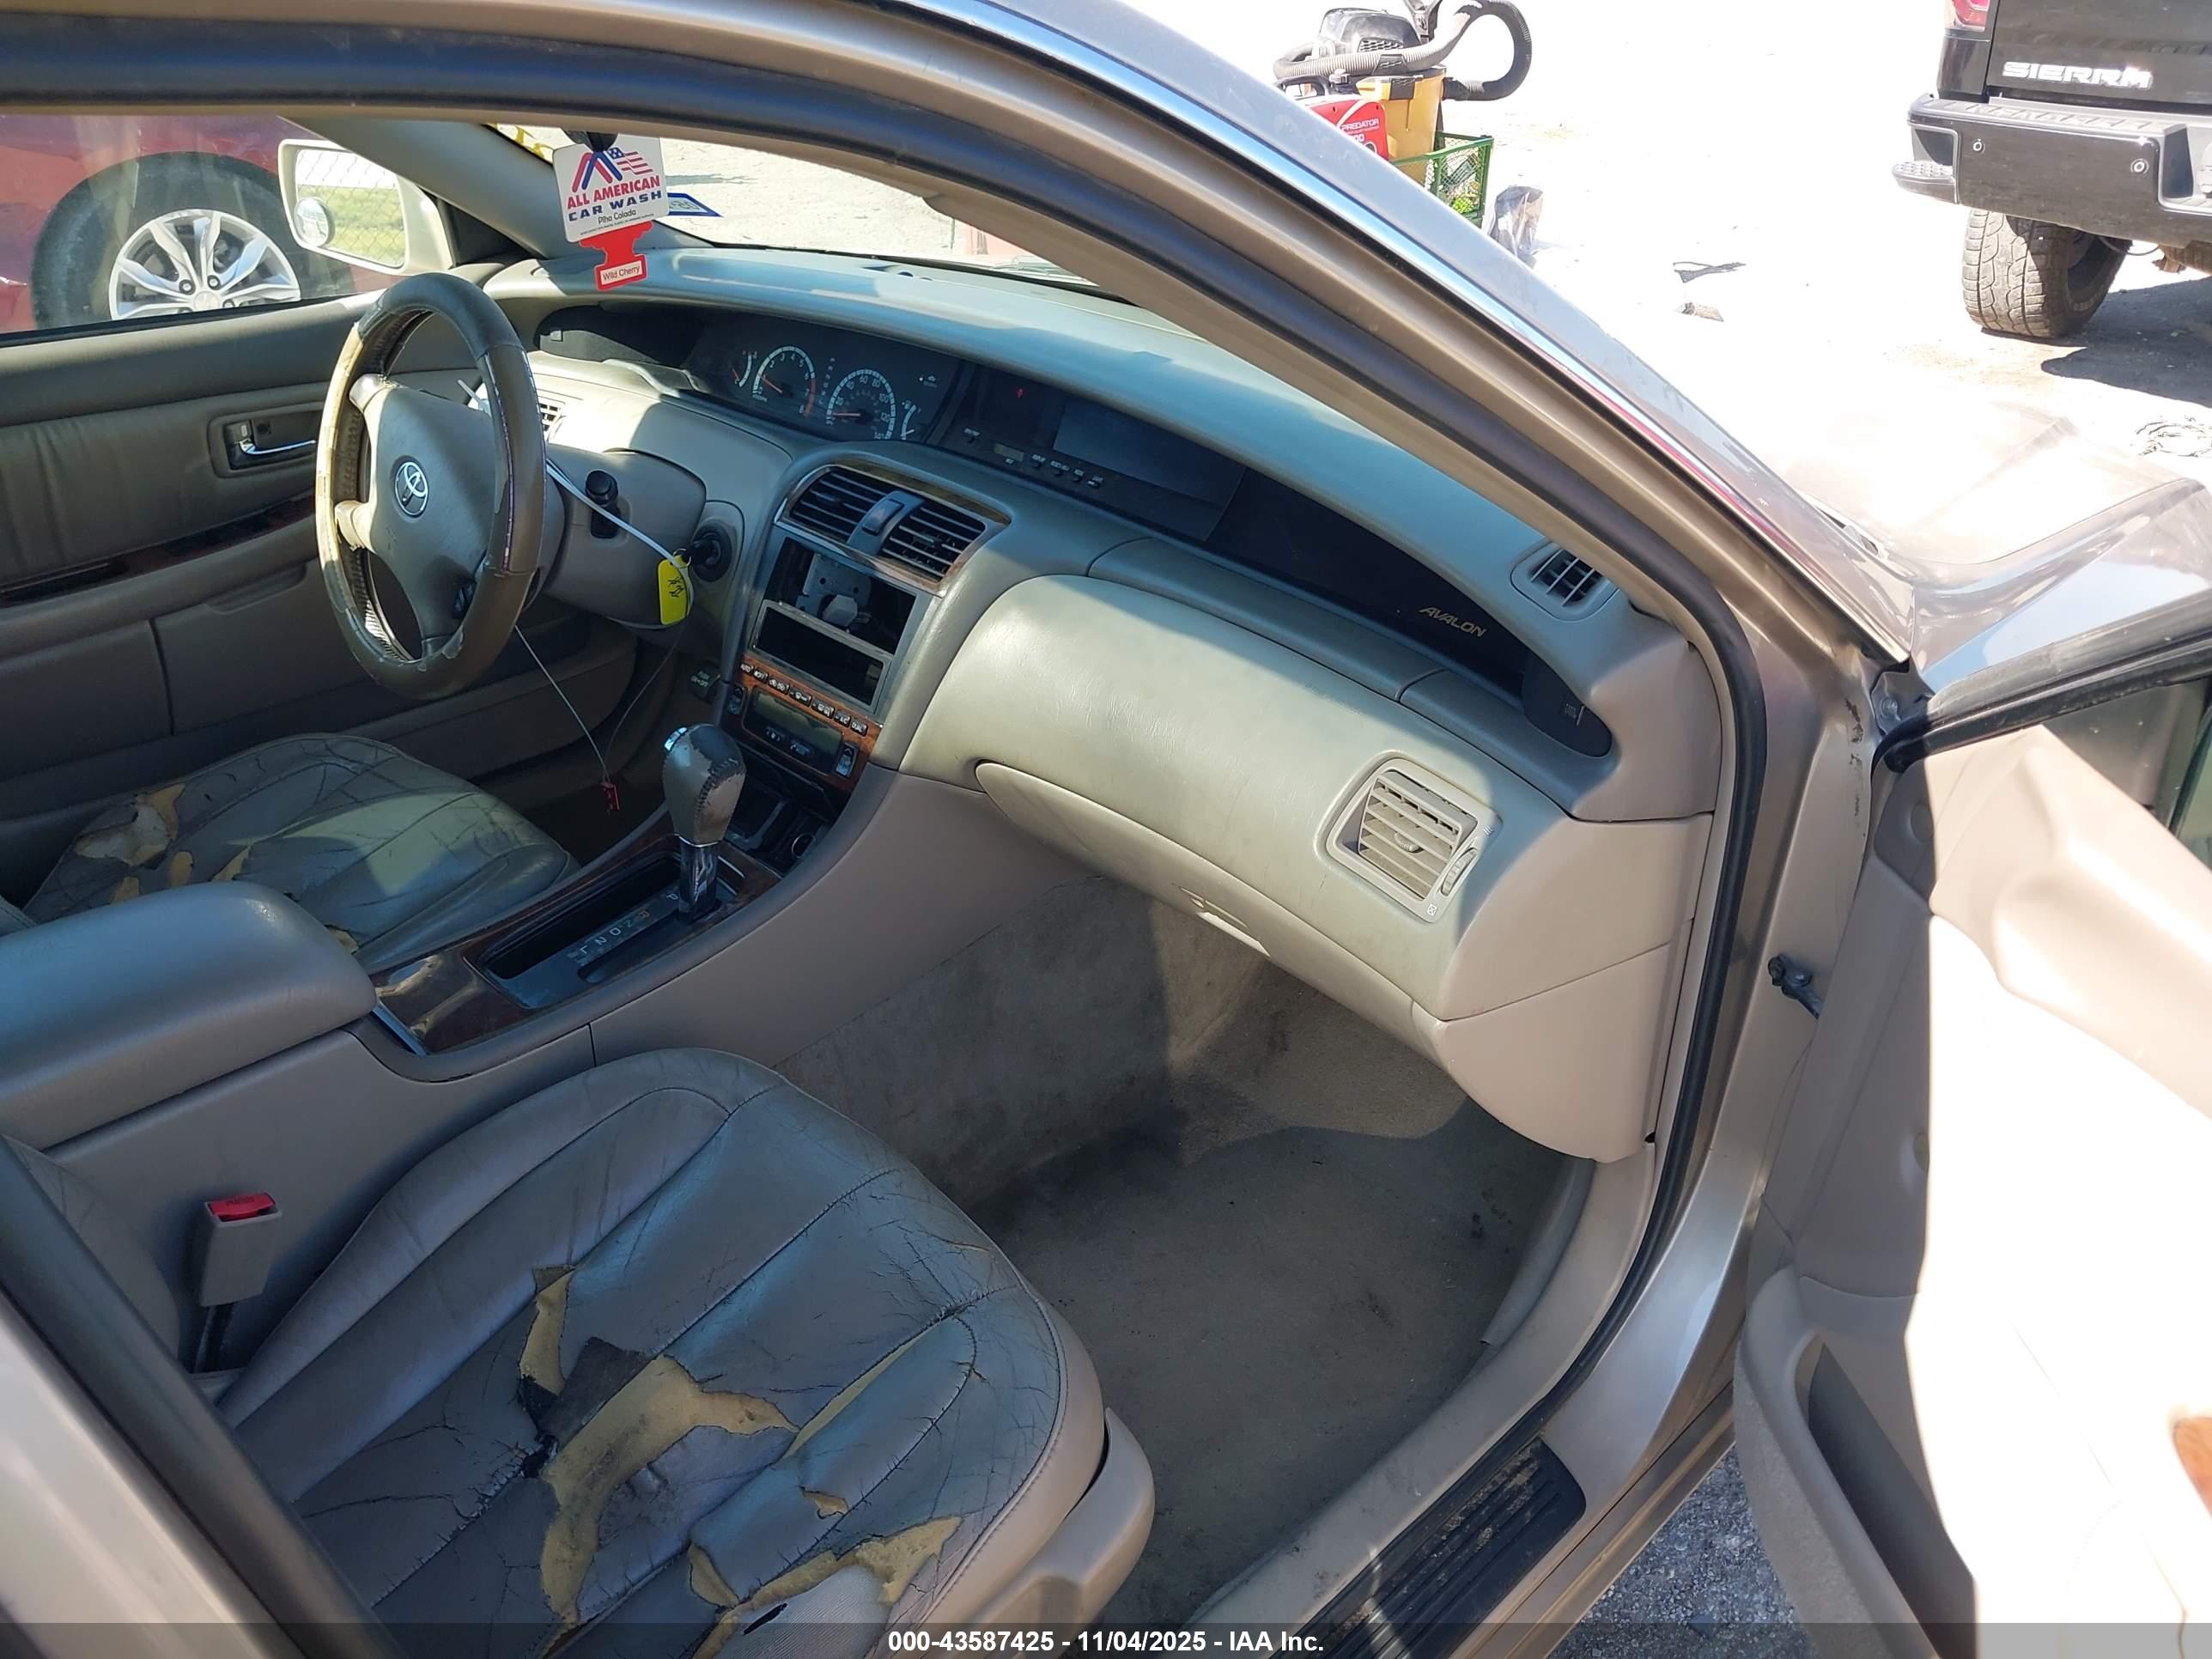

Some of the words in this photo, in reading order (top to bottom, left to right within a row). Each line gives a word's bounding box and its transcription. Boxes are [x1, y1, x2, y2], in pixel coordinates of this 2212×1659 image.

[2002, 61, 2153, 89] SIERRA
[1341, 118, 1379, 131] PREDATOR
[568, 193, 590, 210] ALL
[593, 175, 660, 202] AMERICAN
[568, 205, 603, 222] CAR
[610, 191, 661, 210] WASH
[614, 209, 636, 221] Colada
[602, 270, 617, 281] Wild
[619, 265, 640, 276] Cherry
[1419, 606, 1487, 637] AVALON
[610, 927, 622, 936] D
[580, 945, 588, 954] L
